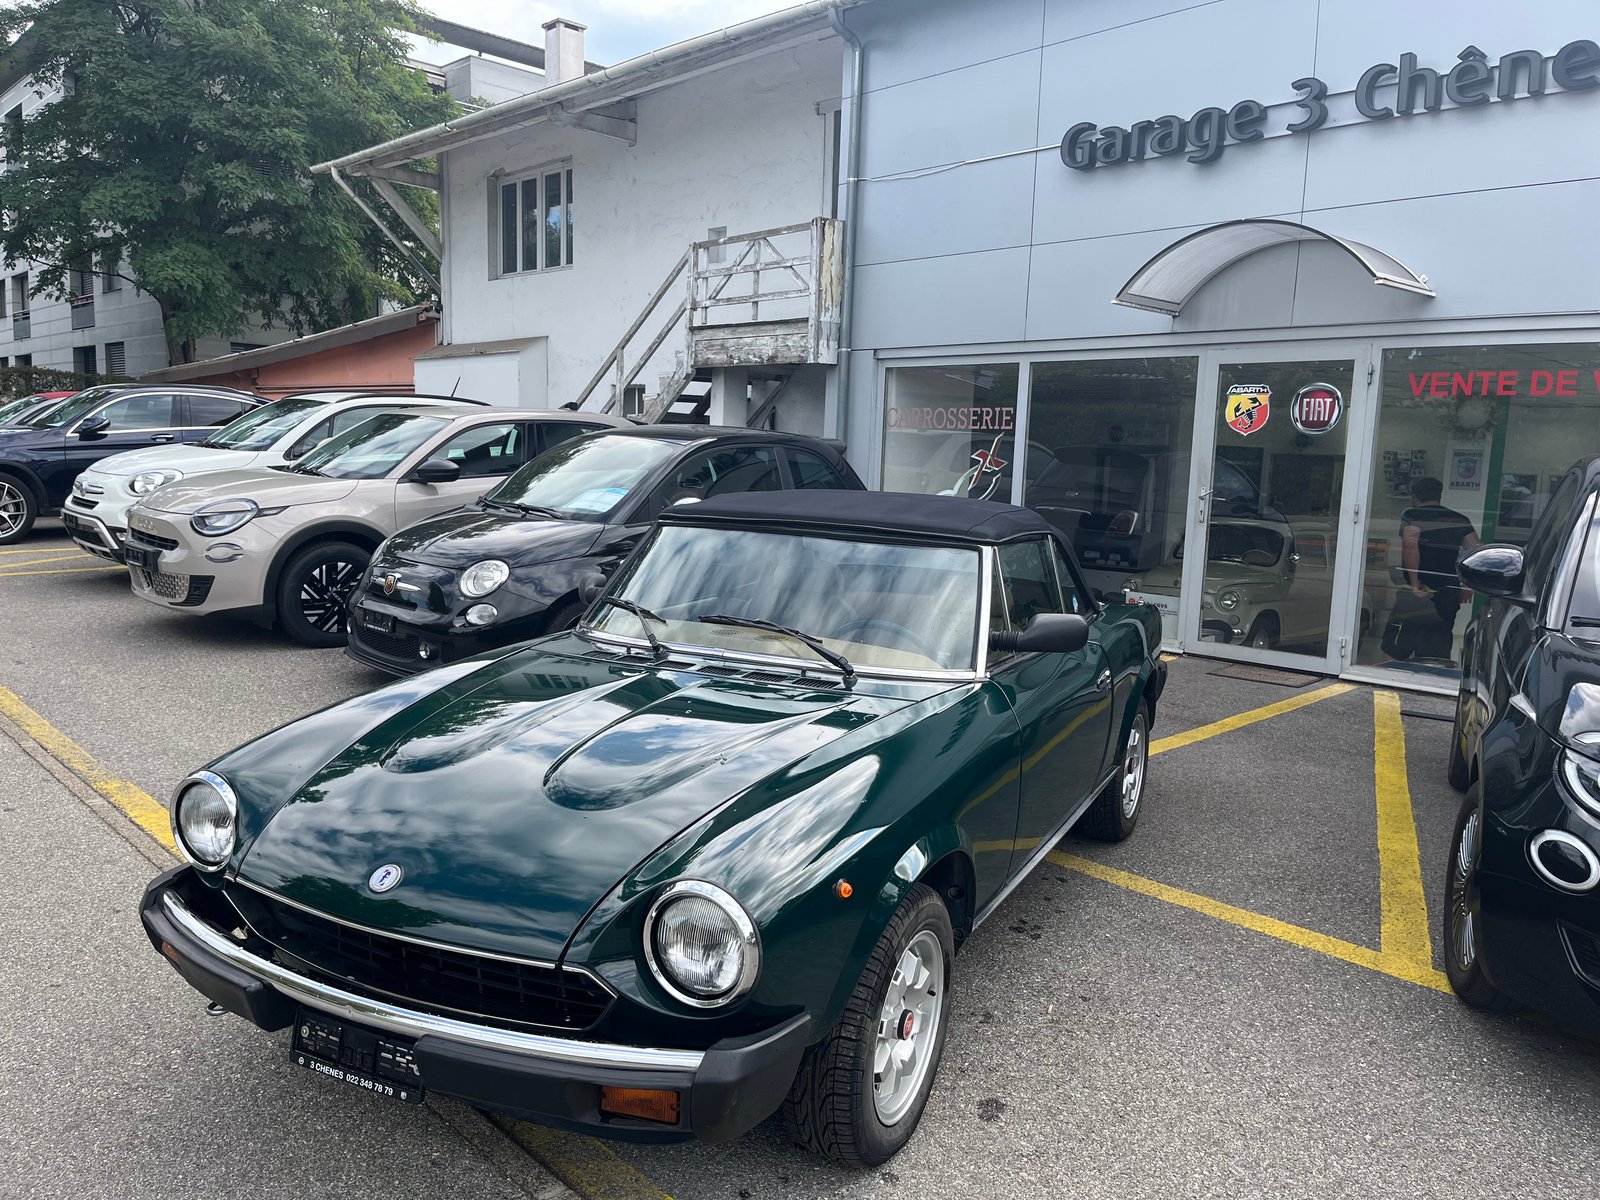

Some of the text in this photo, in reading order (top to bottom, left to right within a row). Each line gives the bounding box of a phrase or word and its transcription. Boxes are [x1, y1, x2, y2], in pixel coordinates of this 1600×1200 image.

[1060, 100, 1268, 170] Garage
[1286, 77, 1329, 134] 3
[1230, 386, 1268, 394] ABARTH
[1408, 370, 1520, 397] VENTE
[1529, 369, 1580, 397] DE
[887, 406, 1014, 430] CARROSSERIE
[1301, 398, 1333, 422] FIAT
[310, 1060, 394, 1096] 3 CHENES 022 348 78 79
